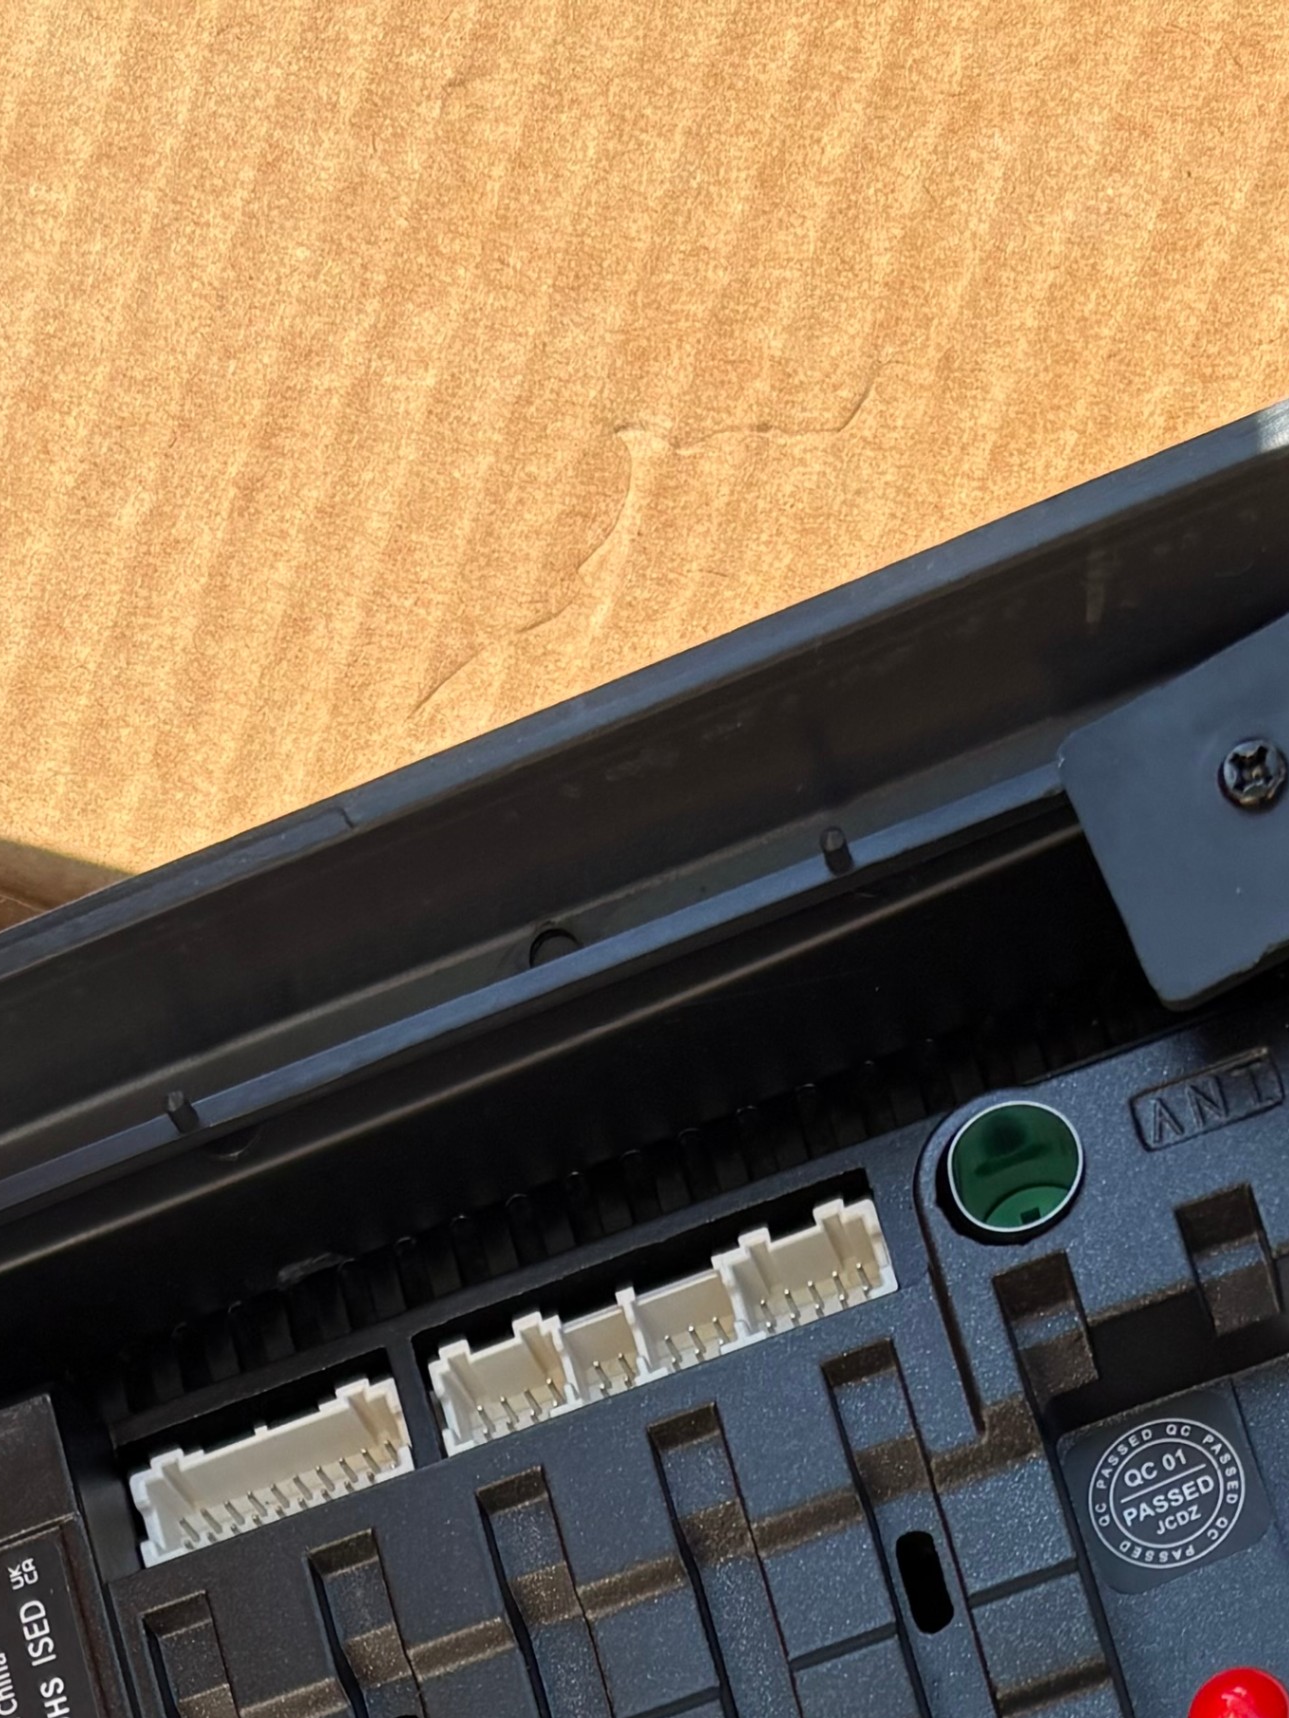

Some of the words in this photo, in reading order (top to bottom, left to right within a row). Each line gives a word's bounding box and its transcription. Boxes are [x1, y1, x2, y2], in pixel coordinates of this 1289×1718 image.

[1151, 1056, 1264, 1144] ANT
[1166, 1424, 1191, 1437] QC
[1096, 1429, 1153, 1490] PASSED
[1124, 1462, 1158, 1487] QC
[1162, 1448, 1187, 1471] 01
[1202, 1434, 1239, 1505] PASSED
[1095, 1502, 1111, 1527] QC
[1123, 1474, 1215, 1527] PASSED
[1156, 1504, 1202, 1535] JCDZ
[1207, 1517, 1229, 1541] QC
[1119, 1540, 1195, 1562] PASSED
[19, 1599, 57, 1667] ISED
